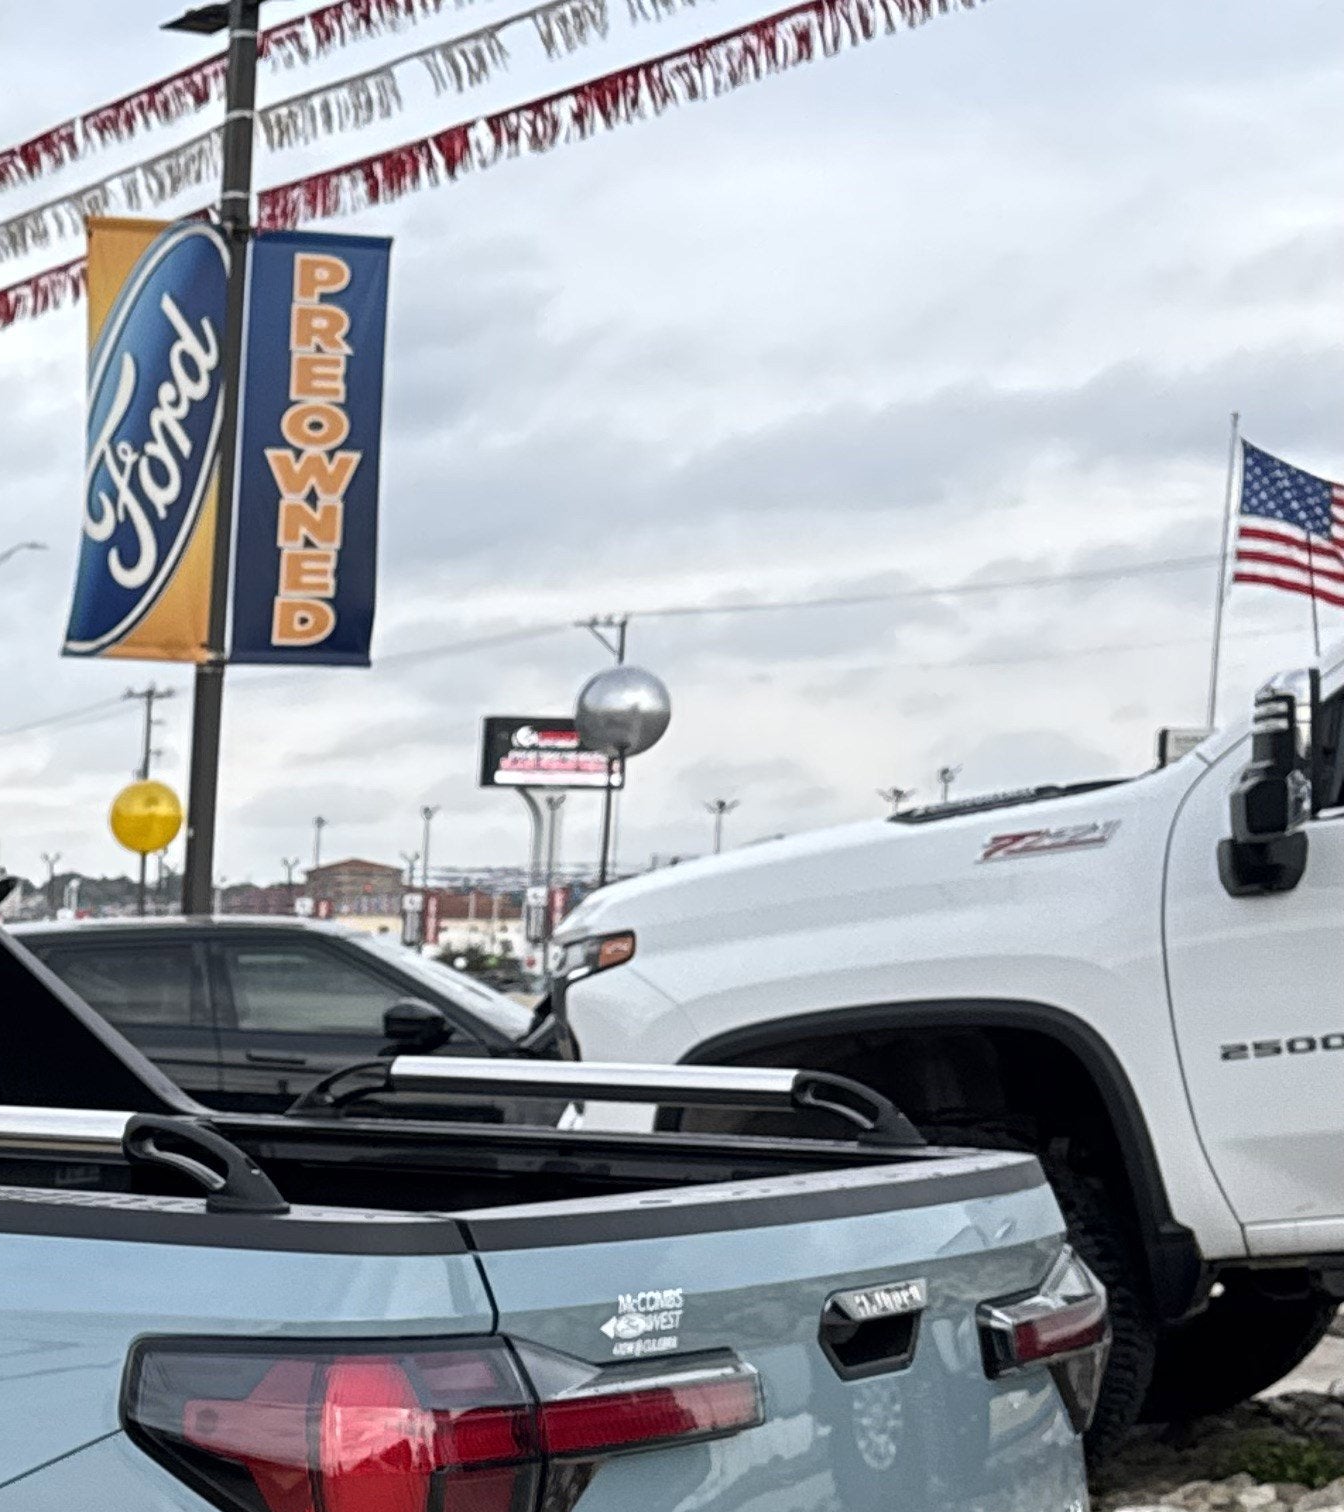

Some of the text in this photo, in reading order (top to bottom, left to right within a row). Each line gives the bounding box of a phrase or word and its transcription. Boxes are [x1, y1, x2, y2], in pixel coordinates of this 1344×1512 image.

[83, 292, 220, 590] Ford
[263, 251, 363, 648] PREOWNED
[1220, 1033, 1344, 1061] 2500
